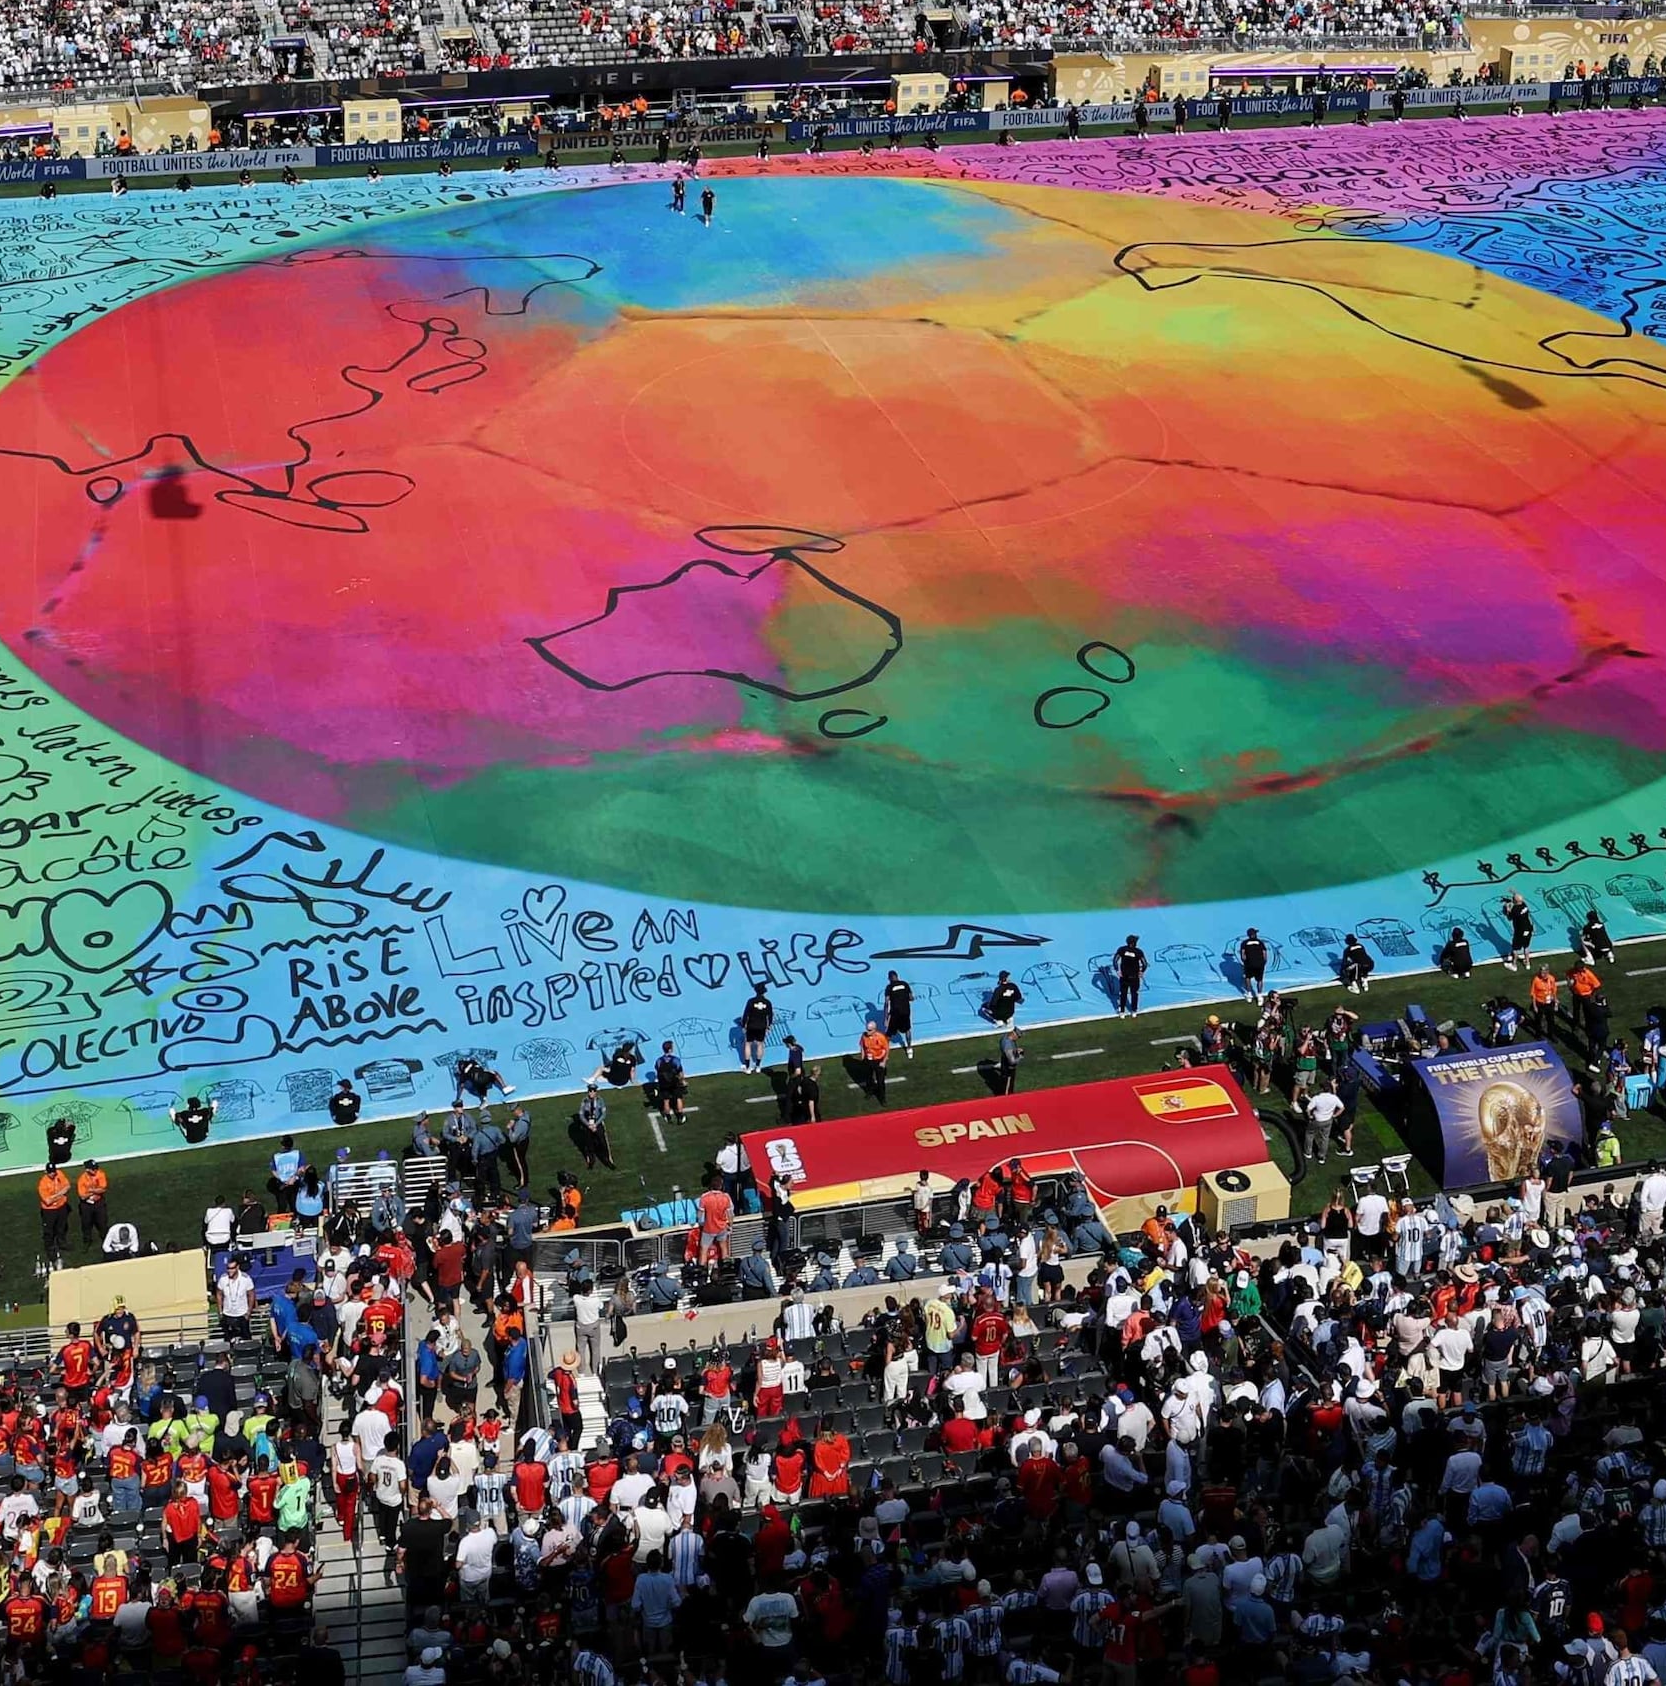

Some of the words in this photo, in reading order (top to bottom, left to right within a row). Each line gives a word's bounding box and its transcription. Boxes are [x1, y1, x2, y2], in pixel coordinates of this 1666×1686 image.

[1599, 33, 1629, 44] FIFA
[1430, 89, 1460, 104] UNITES
[1462, 87, 1482, 102] the
[1482, 85, 1513, 101] World
[1517, 88, 1538, 98] FIFA
[552, 133, 609, 150] UNITED
[677, 129, 698, 144] OF
[700, 125, 773, 143] AMERICA
[855, 120, 891, 135] UNITES
[893, 118, 913, 134] the
[913, 115, 949, 132] World
[953, 117, 977, 127] FIFA
[331, 146, 386, 163] FOOTBALL
[389, 143, 428, 161] UNITES
[430, 141, 452, 159] the
[452, 138, 491, 157] World
[496, 141, 521, 152] FIFA
[43, 165, 71, 176] FIFA
[631, 906, 699, 951] AN
[1426, 1064, 1451, 1073] FIFA
[1451, 1057, 1487, 1072] WORLD
[1488, 1055, 1508, 1065] CUP
[1508, 1048, 1546, 1061] 2026
[1433, 1069, 1482, 1085] THE
[1484, 1057, 1554, 1080] FINAL
[914, 1113, 1035, 1148] SPAIN
[273, 1568, 302, 1592] 24
